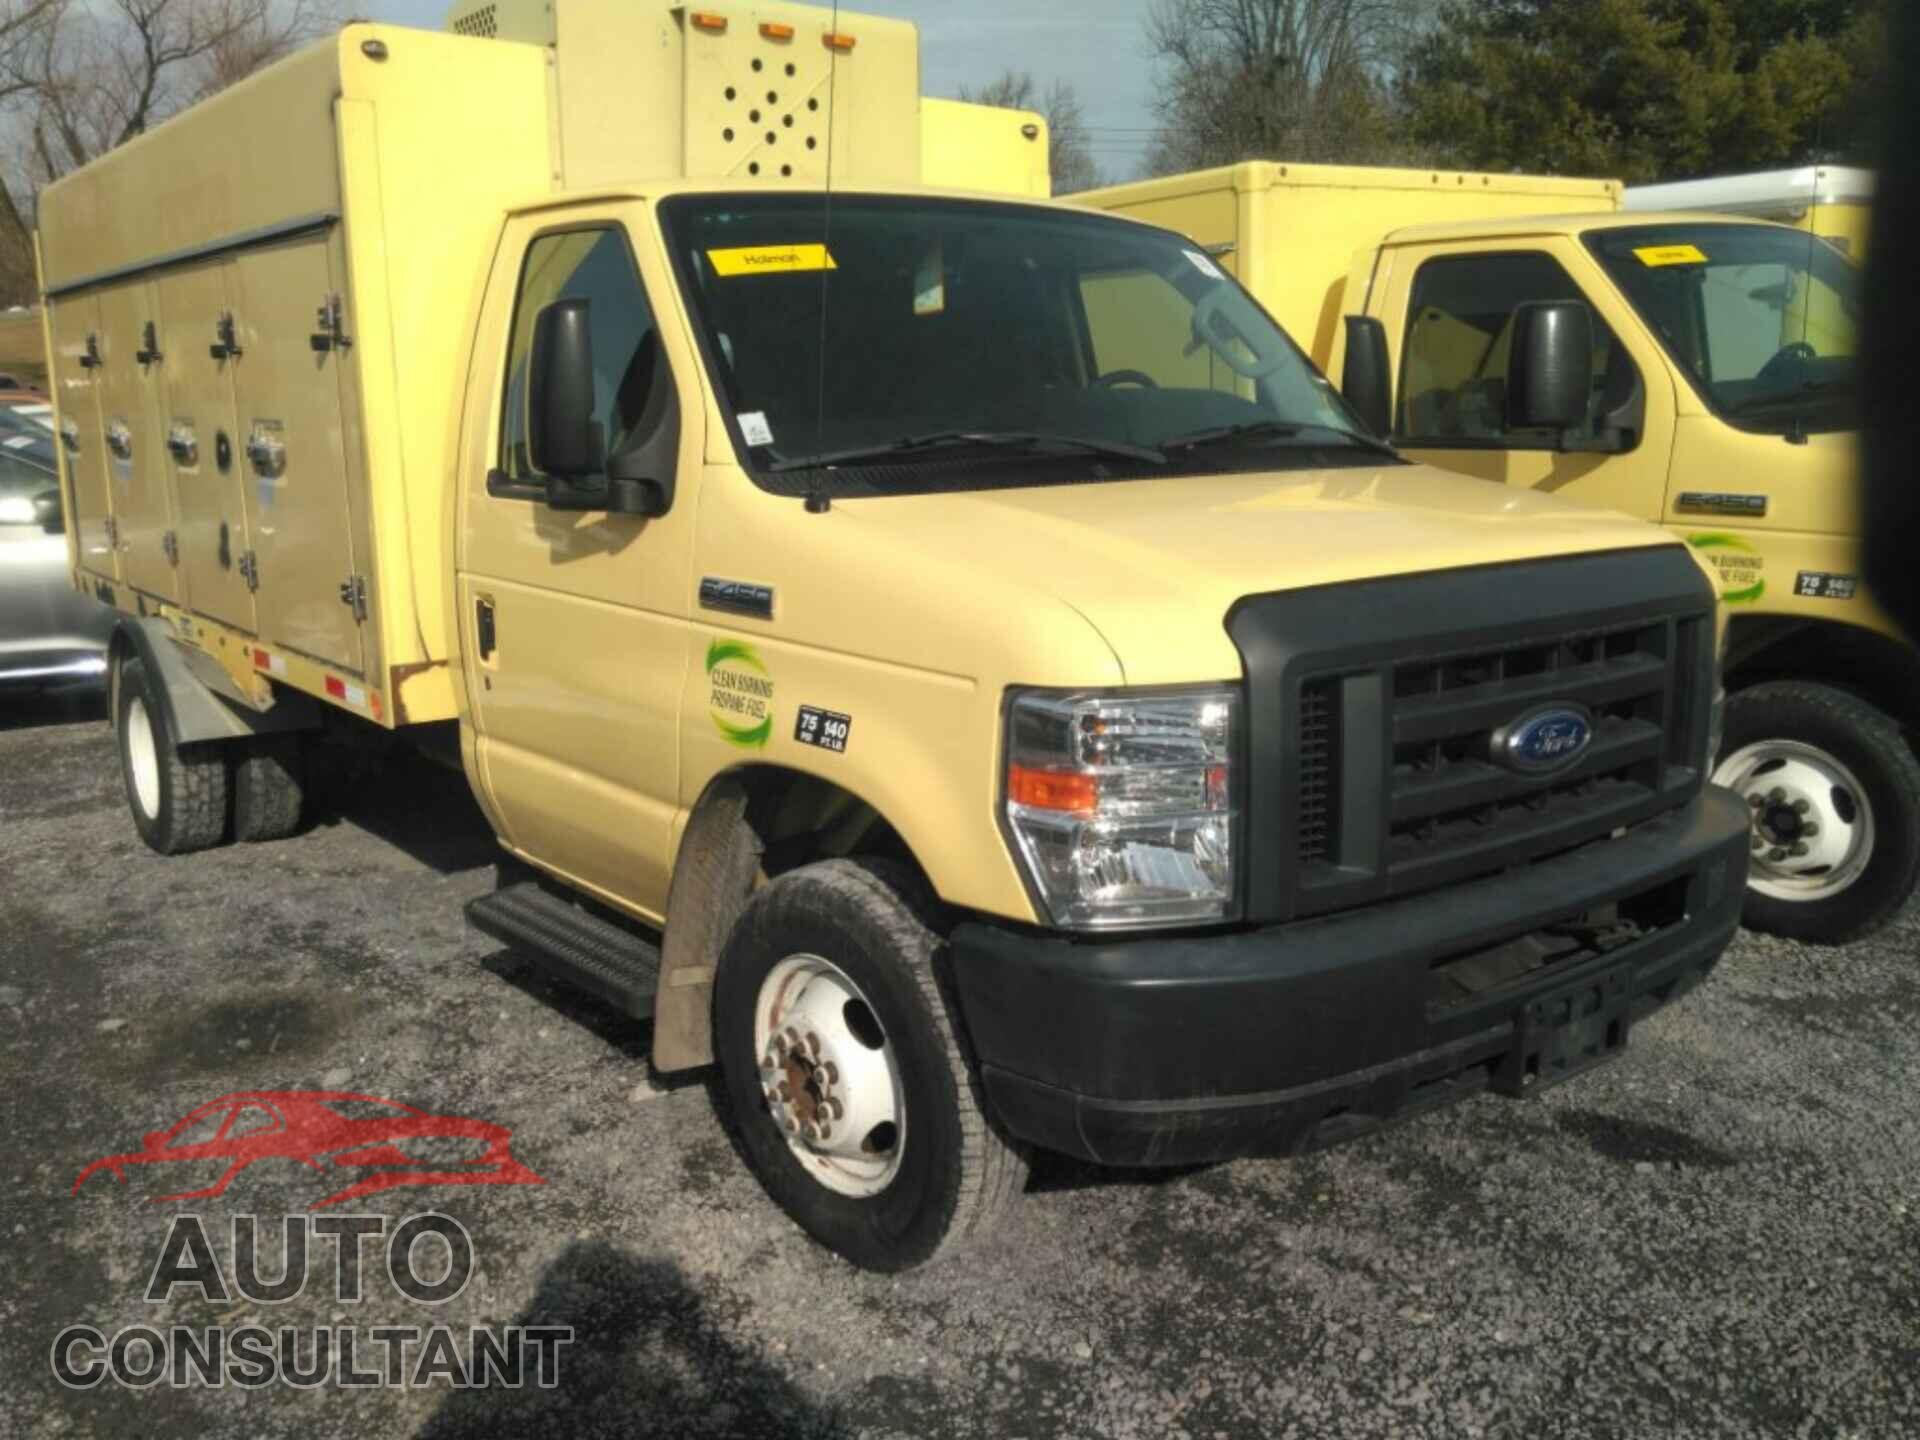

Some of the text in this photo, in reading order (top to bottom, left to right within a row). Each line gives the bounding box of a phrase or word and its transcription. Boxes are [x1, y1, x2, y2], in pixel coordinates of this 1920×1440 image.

[711, 668, 774, 699] CLEAN BURNING
[710, 688, 766, 719] PROPANE FUEL
[801, 713, 819, 731] 75
[824, 720, 847, 739] 140
[1533, 724, 1578, 754] Ford
